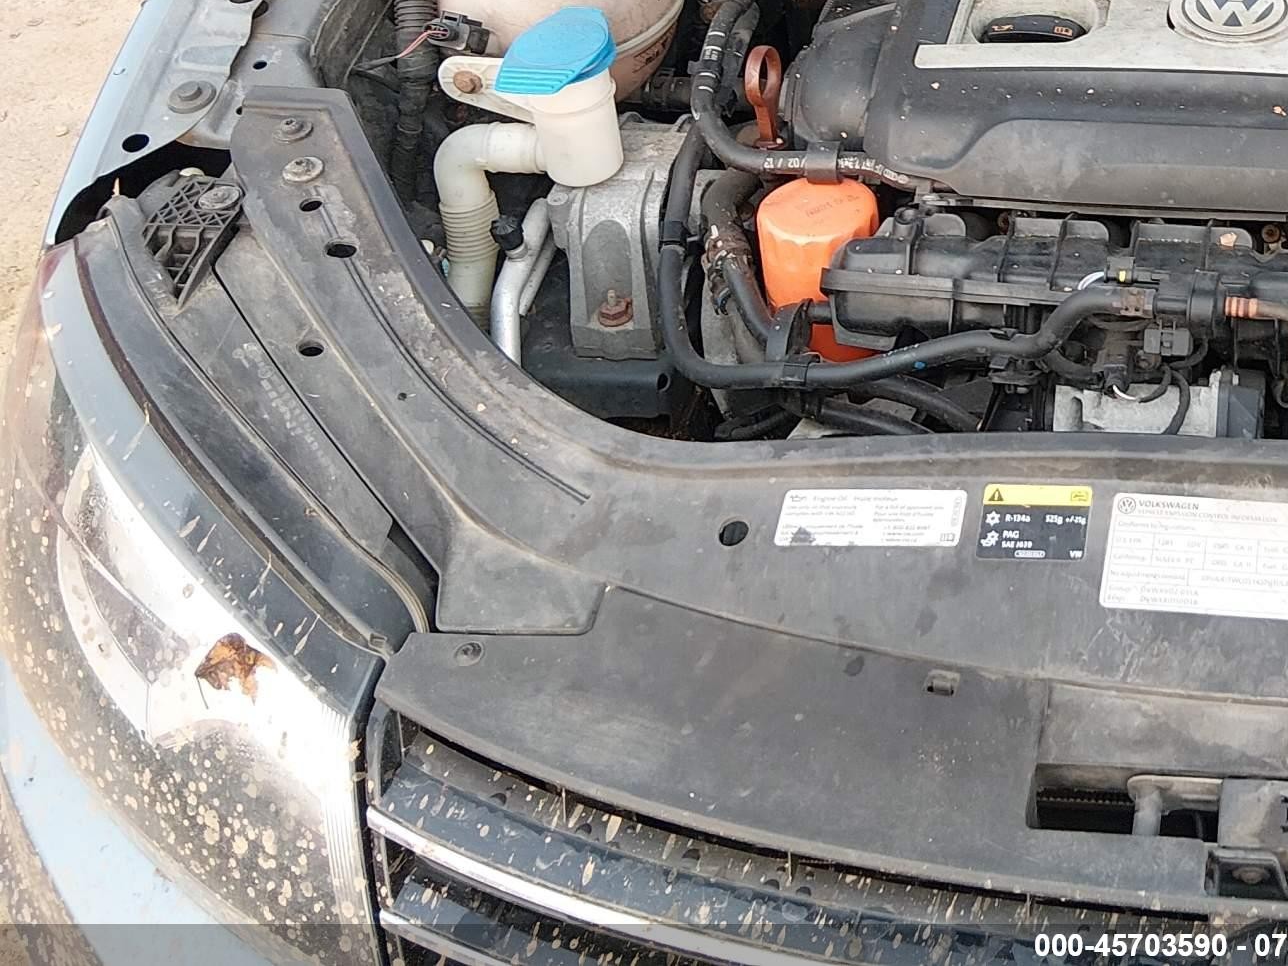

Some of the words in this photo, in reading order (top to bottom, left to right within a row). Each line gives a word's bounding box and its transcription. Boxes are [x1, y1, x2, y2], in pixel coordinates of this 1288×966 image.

[1138, 499, 1200, 511] VOLKSWAGEN
[1005, 514, 1031, 523] R-134a
[1003, 530, 1020, 539] PAG
